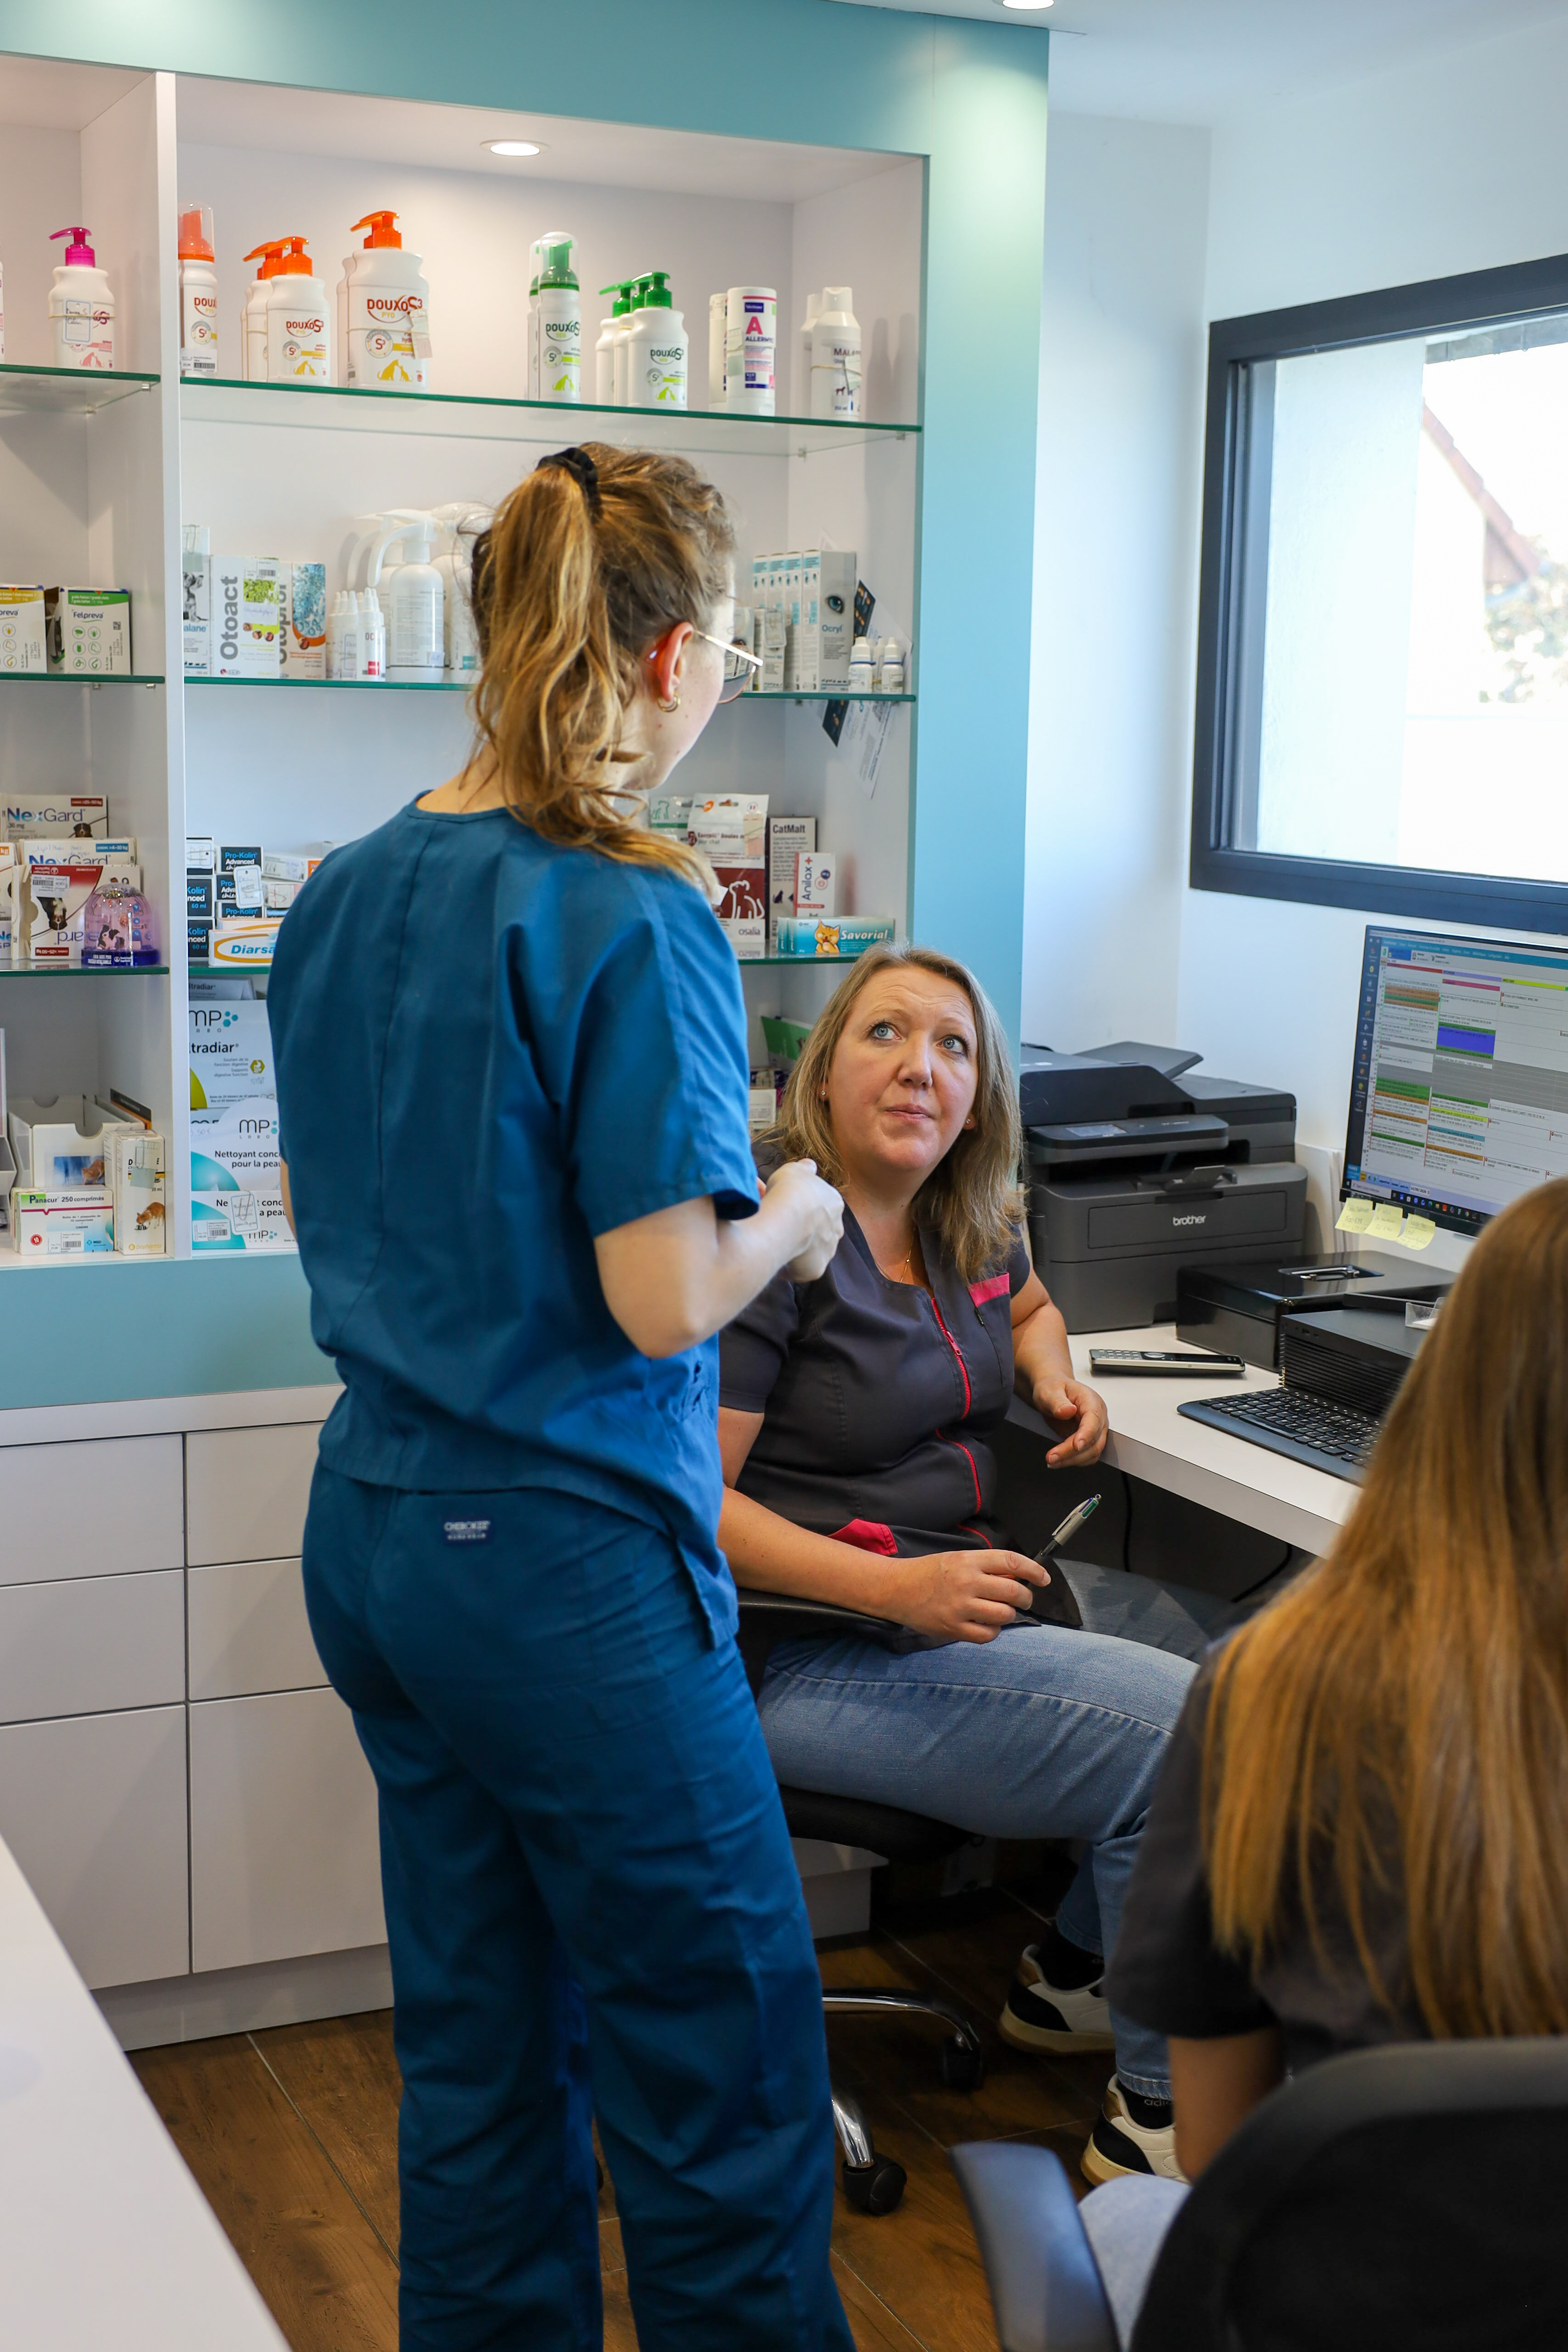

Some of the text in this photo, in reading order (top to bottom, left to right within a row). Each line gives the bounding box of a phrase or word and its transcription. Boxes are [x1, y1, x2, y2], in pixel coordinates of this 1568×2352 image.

[73, 611, 103, 619] Felpreva
[220, 576, 238, 660] Otoact
[822, 624, 842, 633] Ocryl
[7, 807, 83, 822] NexGard
[773, 825, 805, 833] CatMalt
[841, 929, 888, 940] Savorial
[215, 1150, 256, 1160] Nettoyant
[30, 1195, 57, 1204] Panacur
[1173, 1215, 1206, 1226] brother
